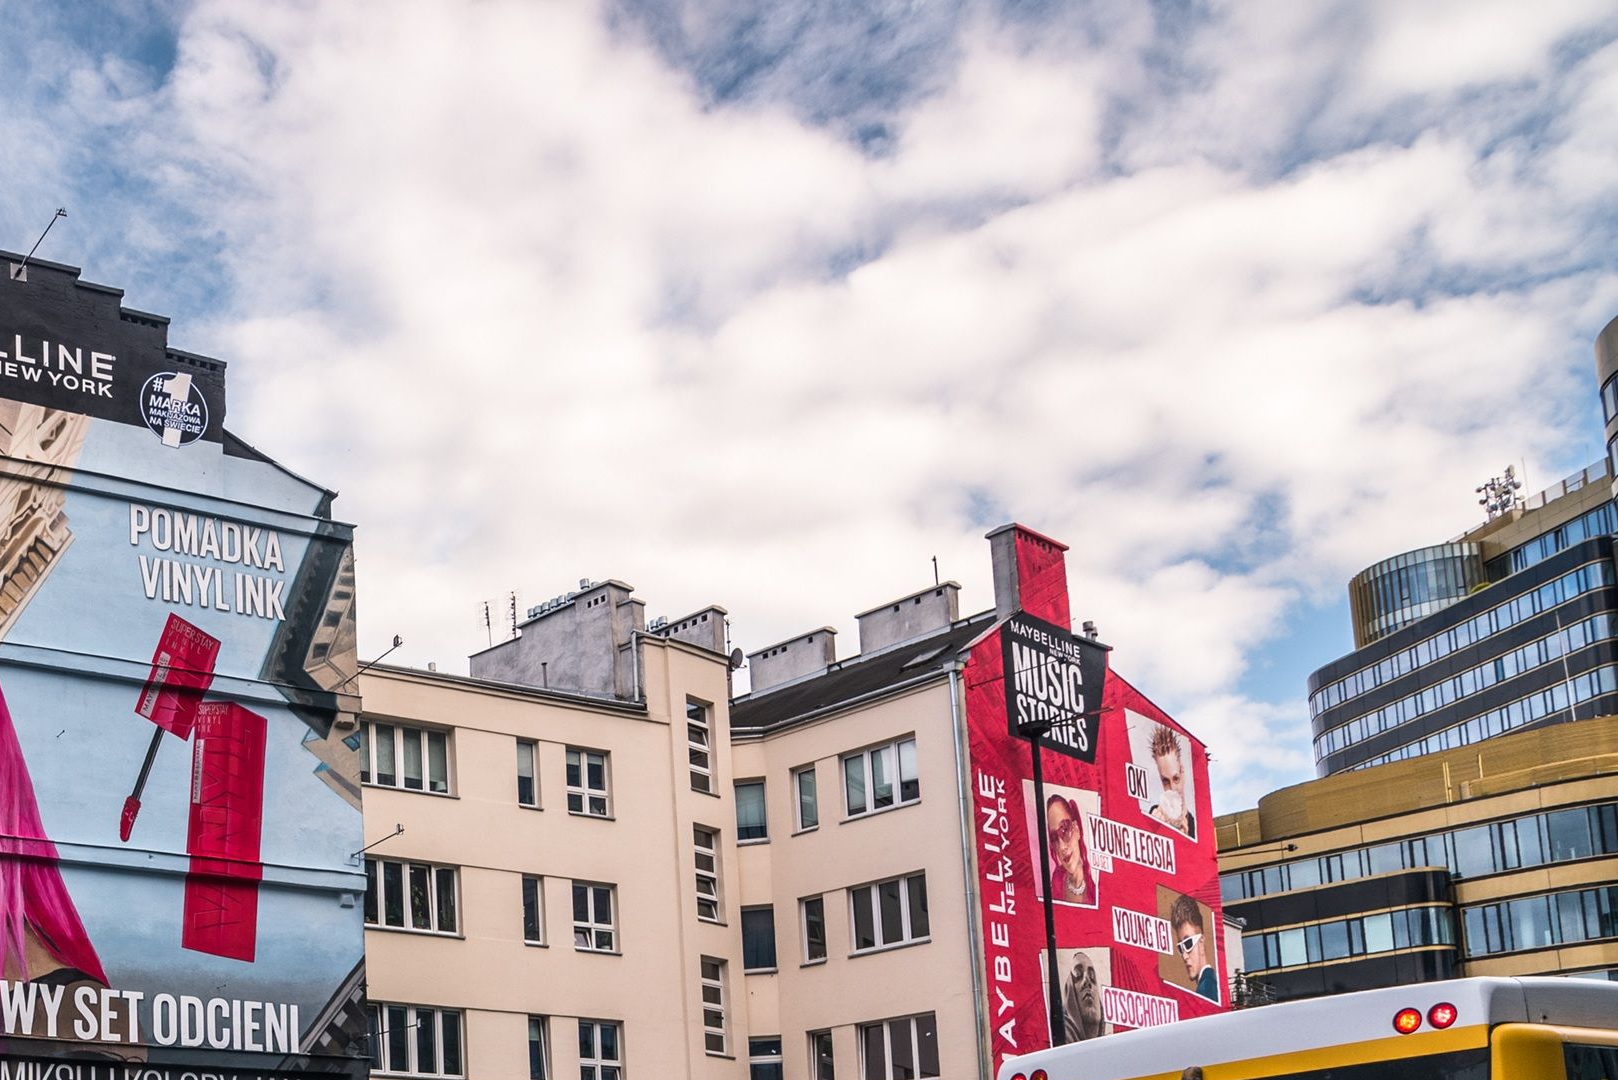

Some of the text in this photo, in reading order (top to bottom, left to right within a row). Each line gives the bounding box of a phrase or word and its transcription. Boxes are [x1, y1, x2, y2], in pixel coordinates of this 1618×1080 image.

[47, 371, 113, 398] YORK
[149, 395, 201, 416] MARKA
[150, 416, 162, 426] NA
[130, 503, 285, 572] POMADKA
[139, 555, 286, 621] VINYL INK
[1010, 620, 1080, 658] MAYBELLINE
[1049, 648, 1063, 657] NEW
[1012, 641, 1084, 713] MUSIC
[1017, 693, 1088, 752] STORIES
[1127, 765, 1148, 799] OKI
[995, 777, 1016, 915] NEW YORK
[1088, 816, 1174, 873] YOUNG LEOSIA
[1114, 908, 1170, 953] YOUNG IGI
[74, 986, 144, 1043] SET
[153, 994, 299, 1053] ODCIENI
